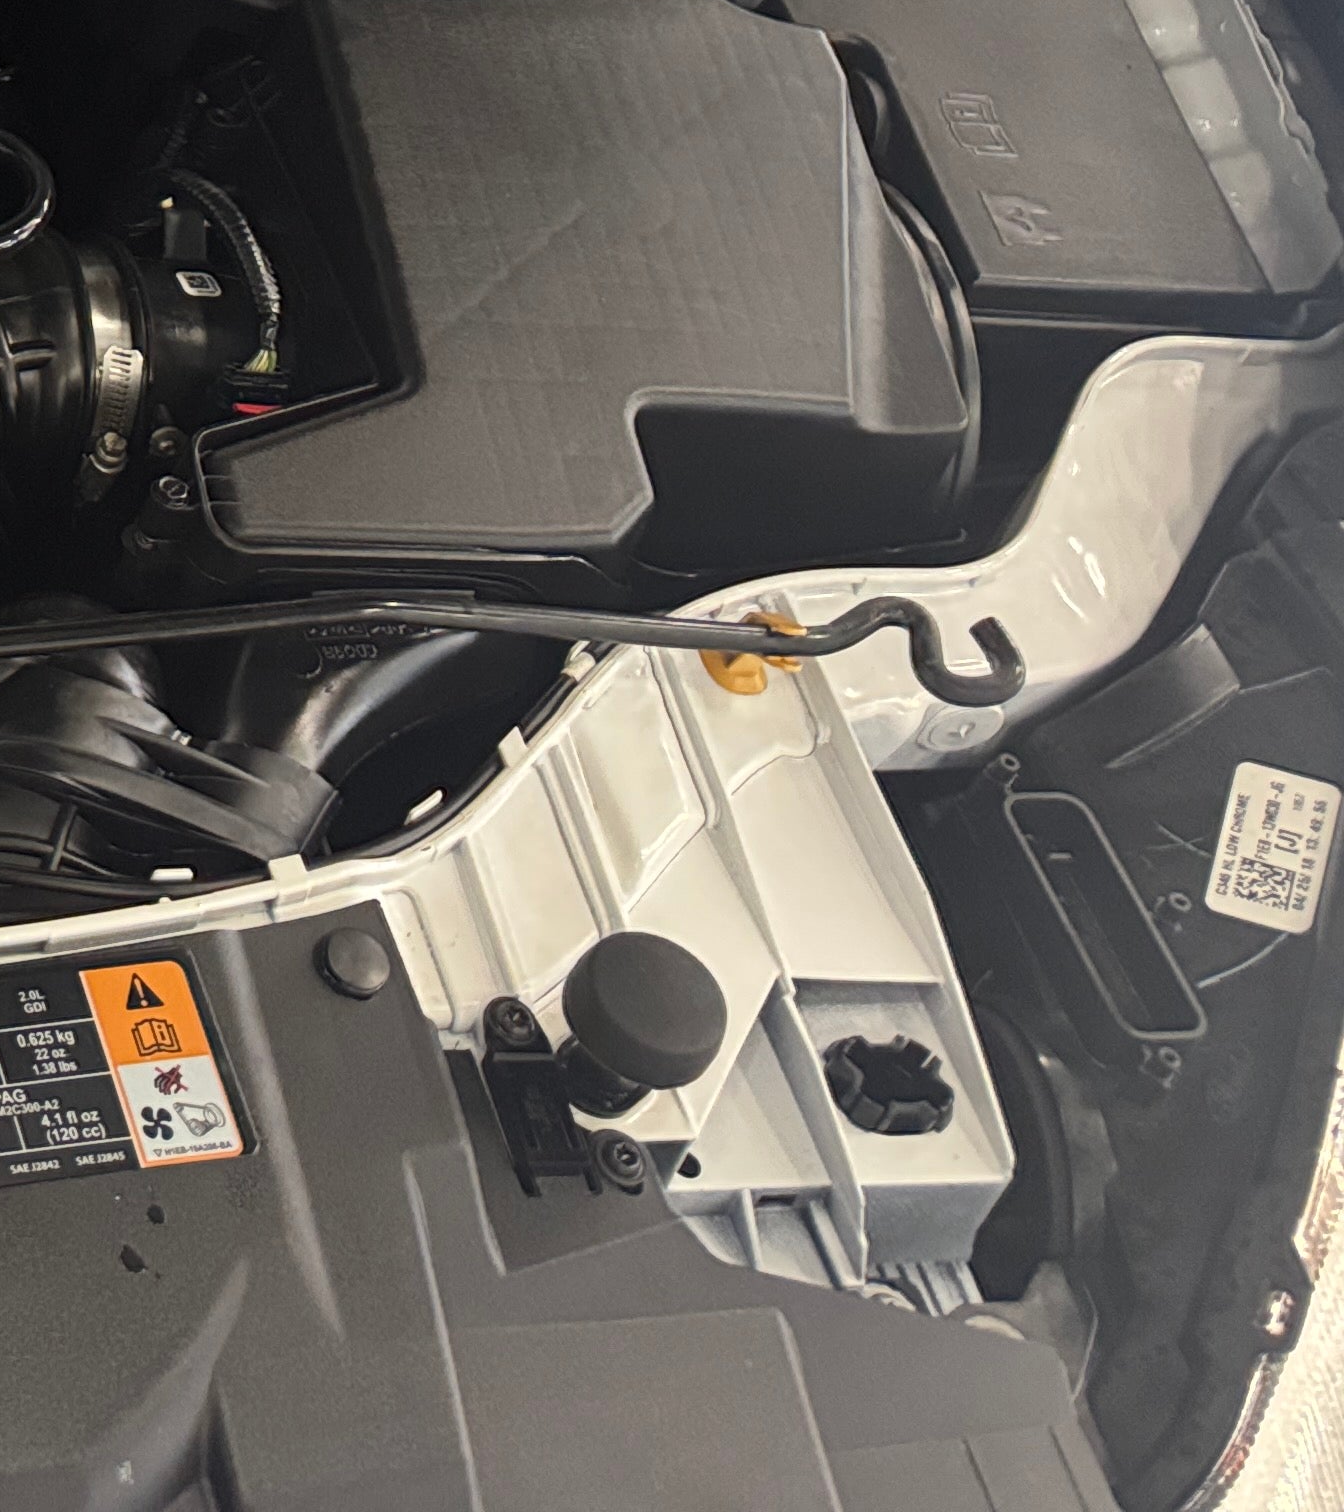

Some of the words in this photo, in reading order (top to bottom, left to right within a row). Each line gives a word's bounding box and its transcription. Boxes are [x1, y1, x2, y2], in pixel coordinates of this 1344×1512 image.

[1224, 836, 1240, 856] LOW
[18, 990, 45, 1002] 2.0L
[24, 1002, 47, 1013] GDI
[16, 1030, 54, 1048] 0.625
[56, 1029, 76, 1045] kg
[34, 1048, 50, 1060] 22
[52, 1048, 67, 1058] oz
[33, 1062, 56, 1076] 1.38
[58, 1061, 78, 1072] lbs
[41, 1113, 63, 1127] 4.1
[66, 1110, 78, 1124] fl
[81, 1110, 101, 1122] oz
[46, 1126, 79, 1145] (120
[82, 1123, 106, 1139] cc)
[10, 1162, 30, 1175] SAE
[32, 1159, 60, 1172] J2842
[75, 1155, 95, 1166] SAE
